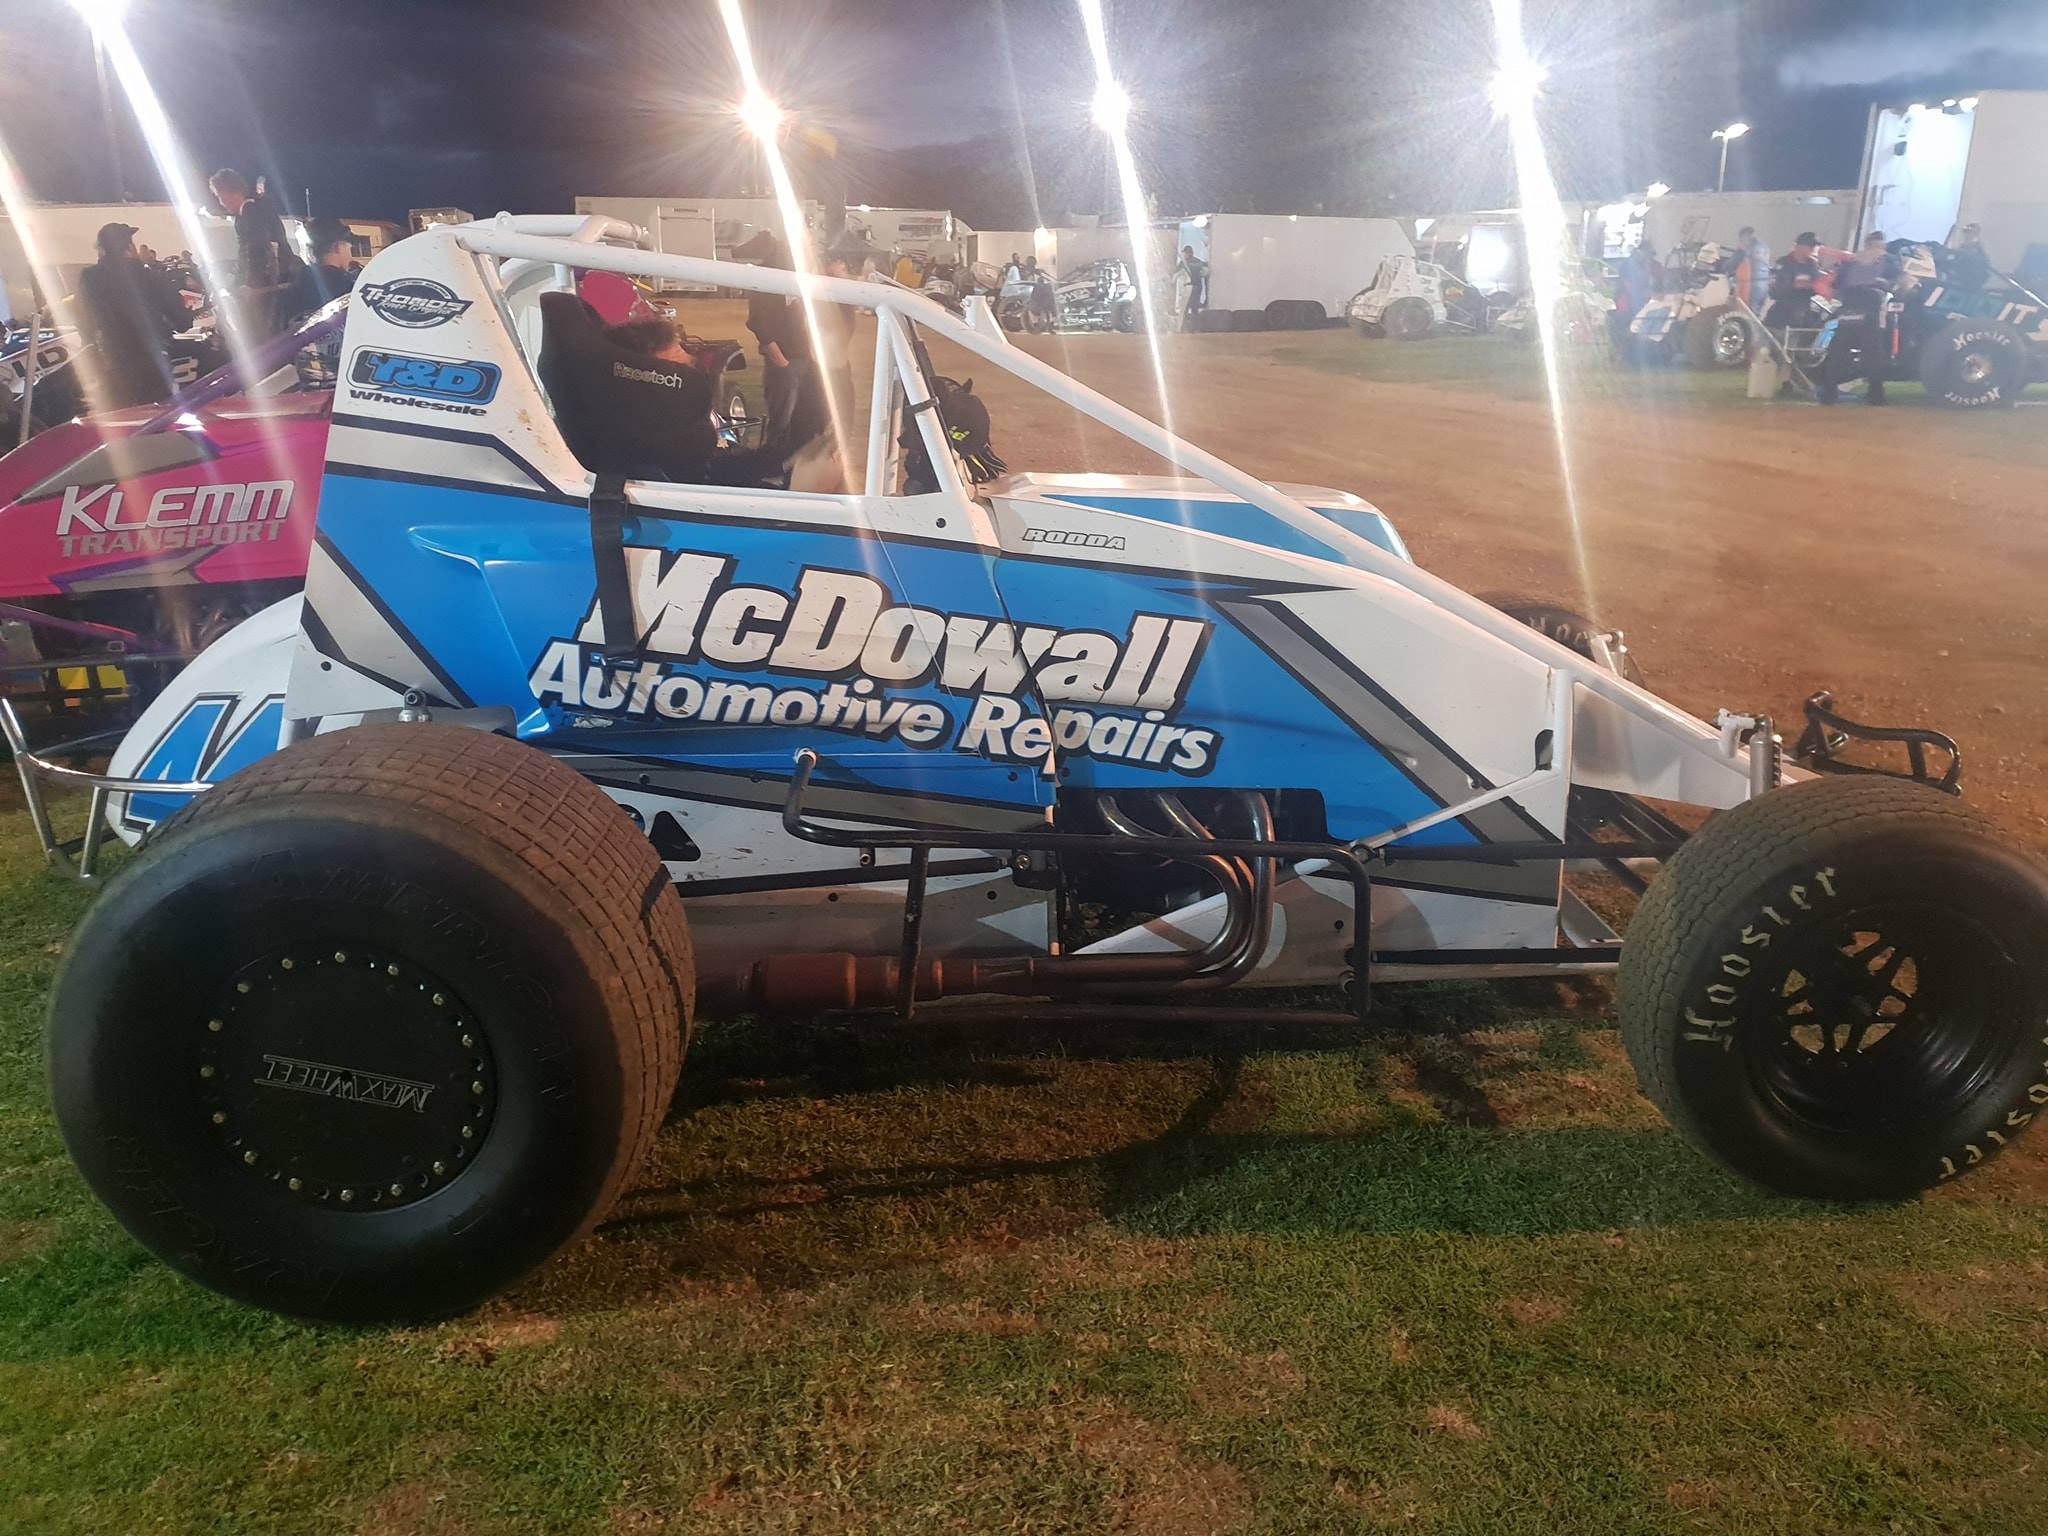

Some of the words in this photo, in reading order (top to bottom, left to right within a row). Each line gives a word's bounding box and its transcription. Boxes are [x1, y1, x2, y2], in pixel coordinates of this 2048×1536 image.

[367, 354, 485, 395] T&D
[350, 389, 487, 416] Wholesale
[56, 479, 295, 536] KLEMM
[58, 520, 287, 558] TRANSPORT
[1022, 527, 1126, 550] RODDA
[578, 547, 1206, 711] McDowall
[535, 641, 944, 742] Automotive
[961, 695, 1216, 776] Repairs
